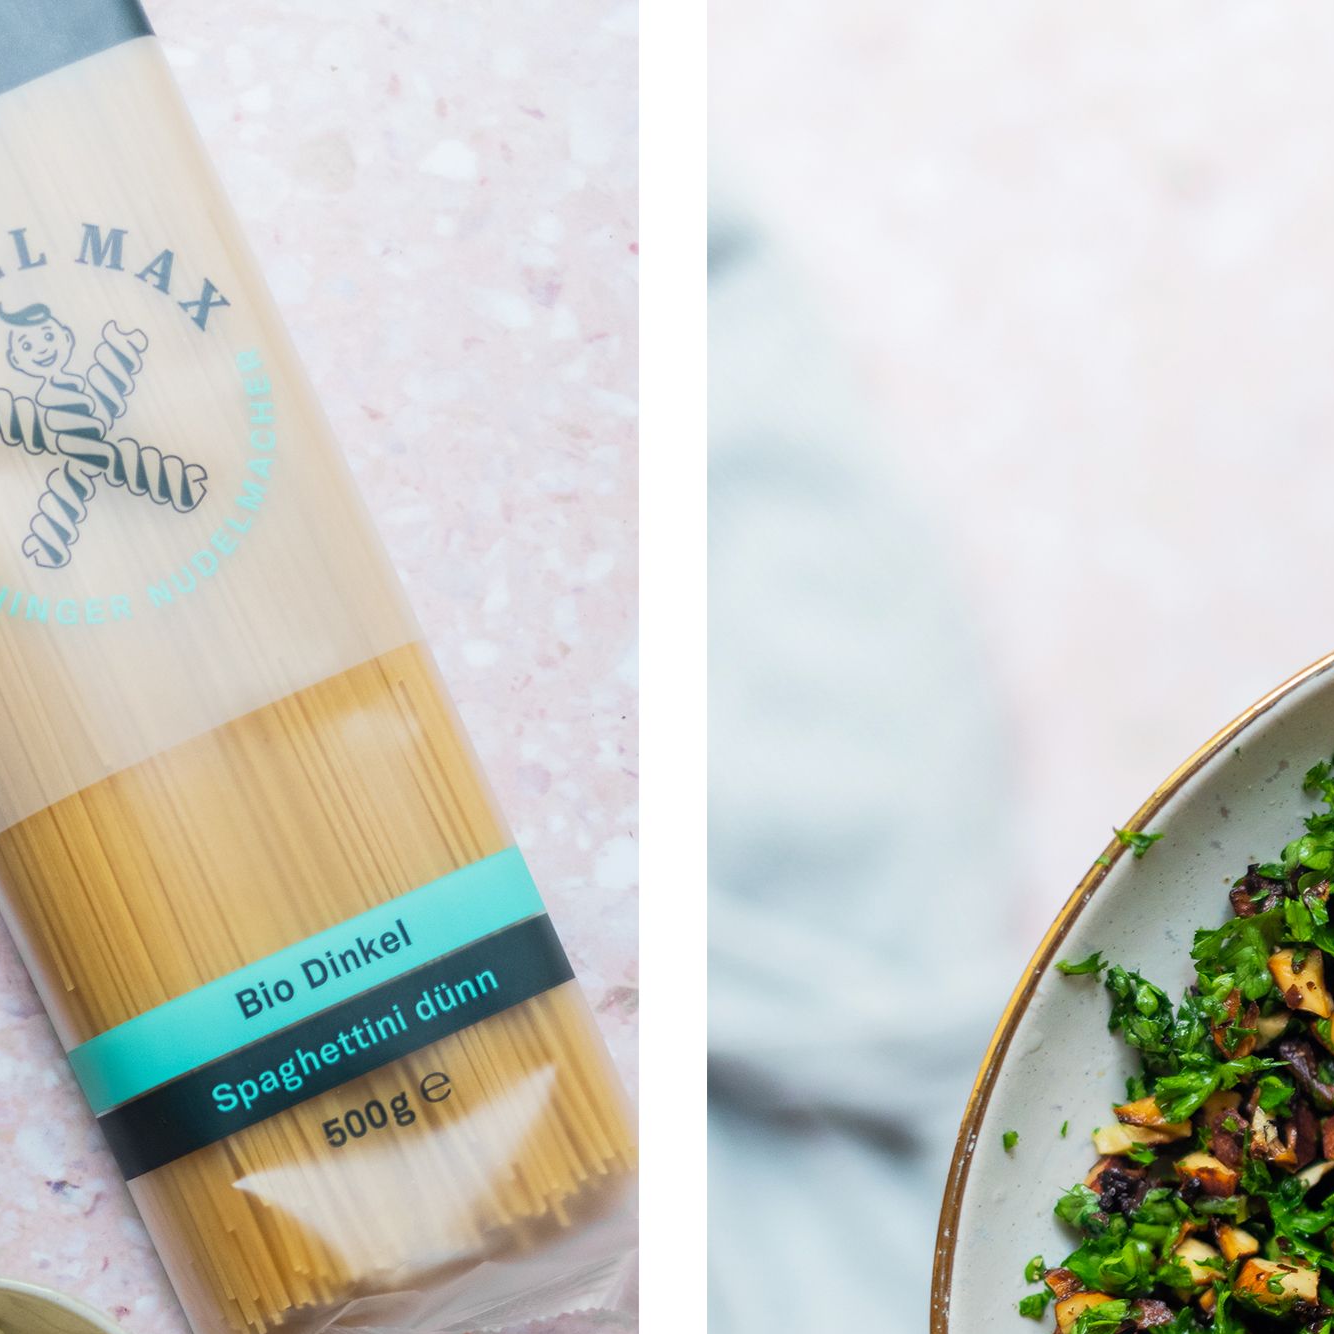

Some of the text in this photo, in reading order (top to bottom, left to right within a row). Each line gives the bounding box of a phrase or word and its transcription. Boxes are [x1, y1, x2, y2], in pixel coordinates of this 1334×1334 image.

[74, 223, 231, 332] MAX
[146, 346, 277, 607] NUDELMACHER
[234, 919, 413, 1020] Bio Dinkel
[211, 966, 500, 1114] Spaghettini dünn
[321, 1089, 416, 1148] 500g
